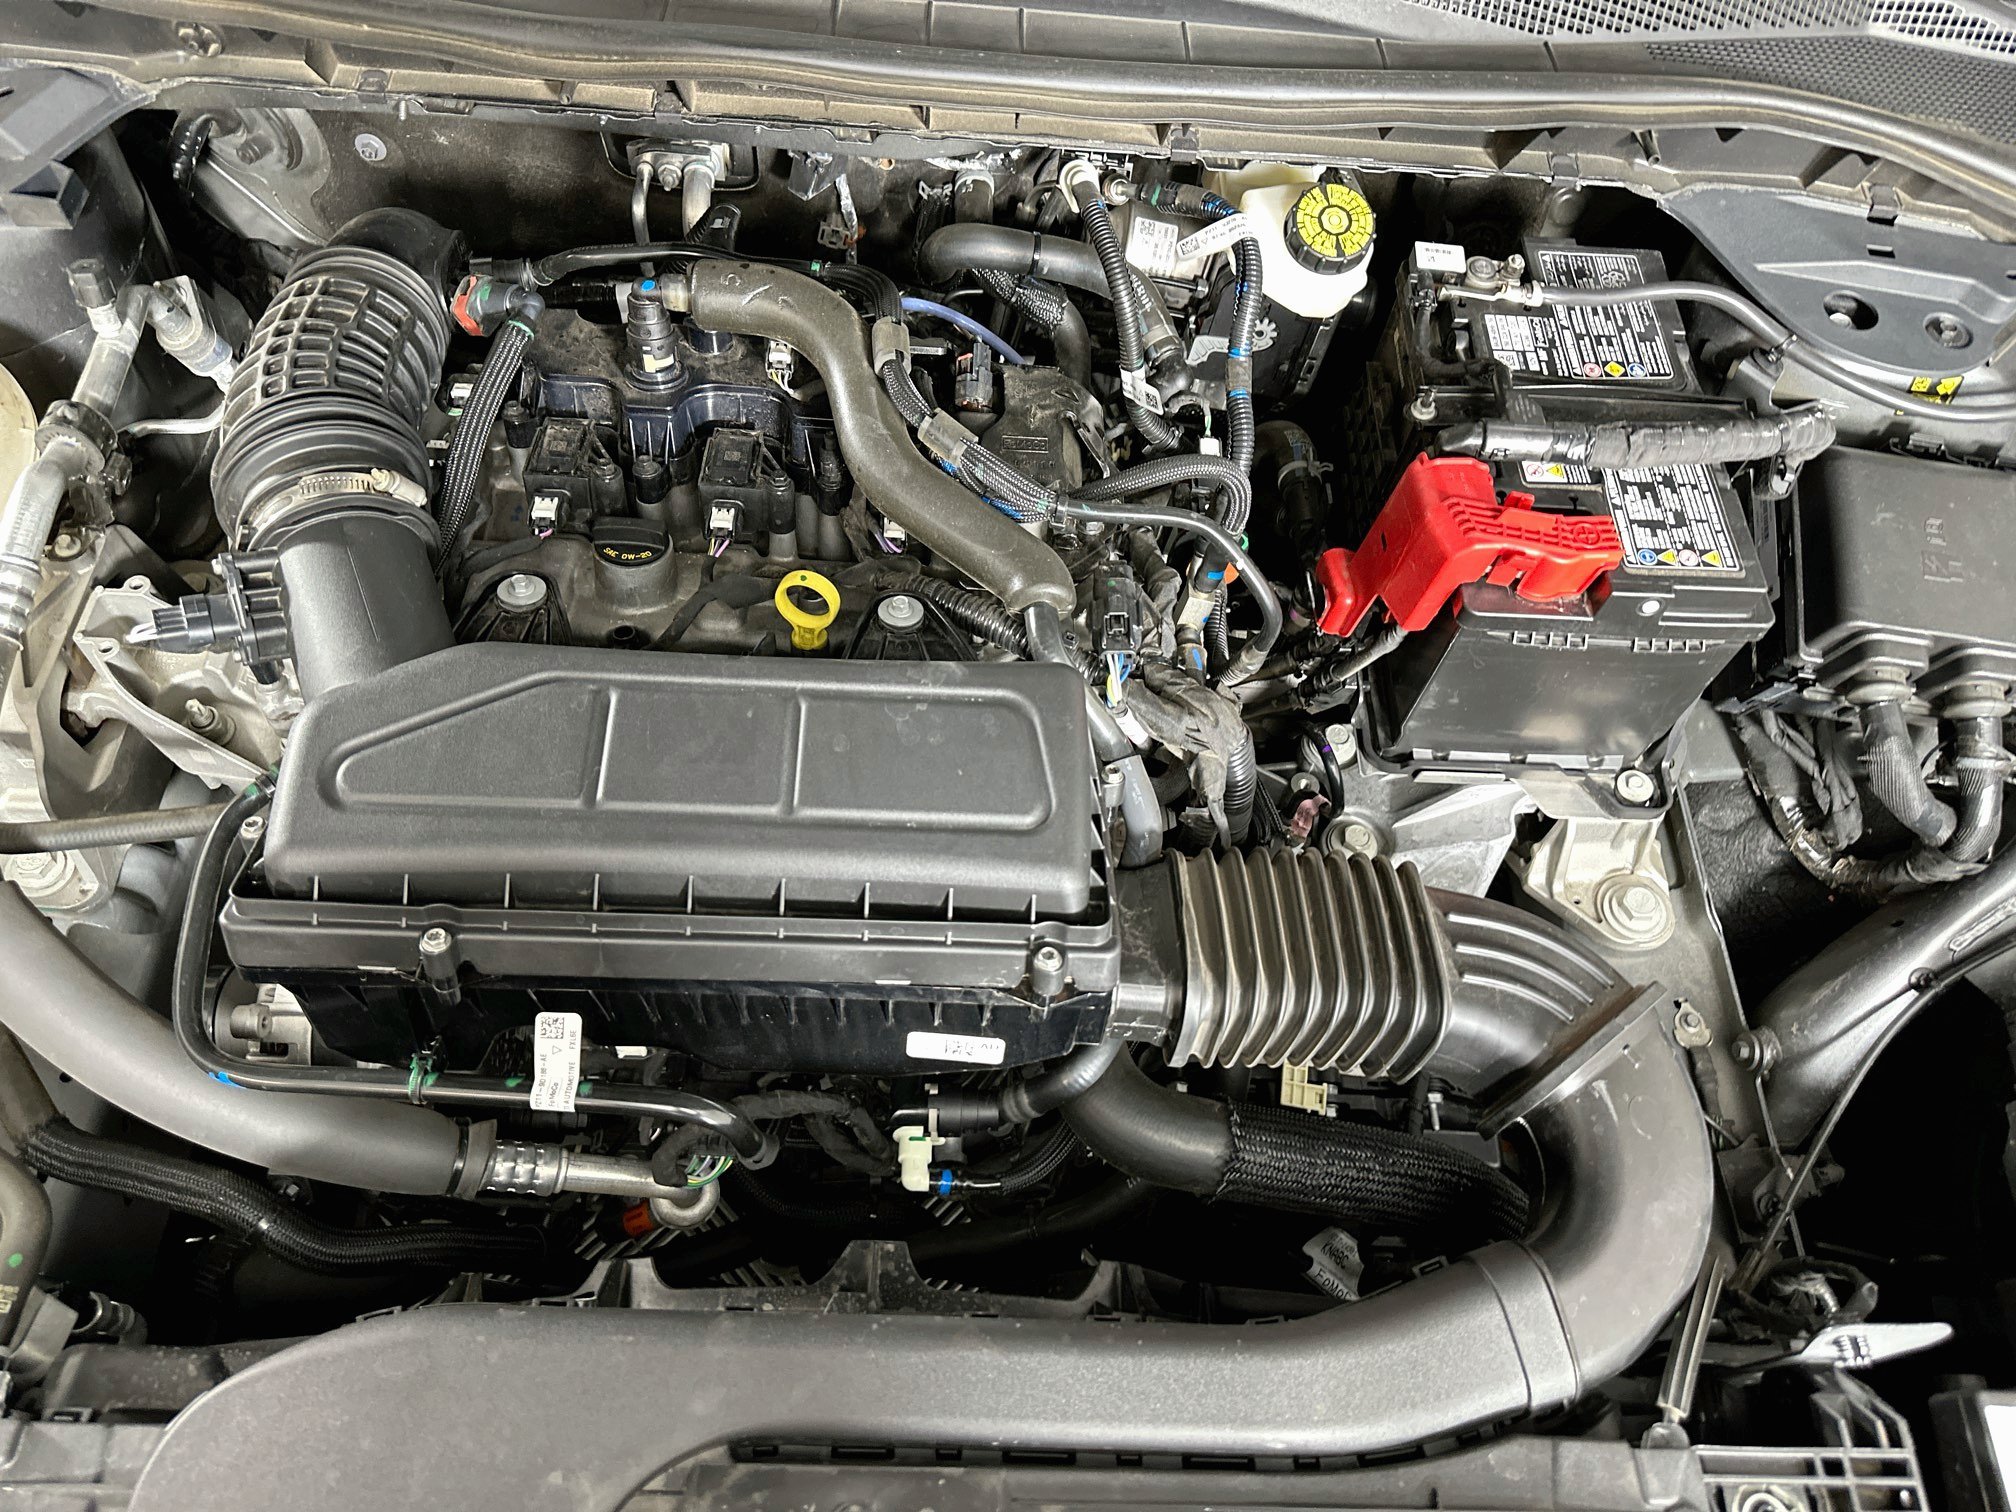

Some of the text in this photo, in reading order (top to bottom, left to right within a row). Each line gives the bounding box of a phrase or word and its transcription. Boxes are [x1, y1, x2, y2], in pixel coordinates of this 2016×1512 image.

[603, 547, 652, 560] SAE 0W-20
[548, 1082, 559, 1107] FoMoCo
[563, 1061, 576, 1104] AUTOMOTIVE
